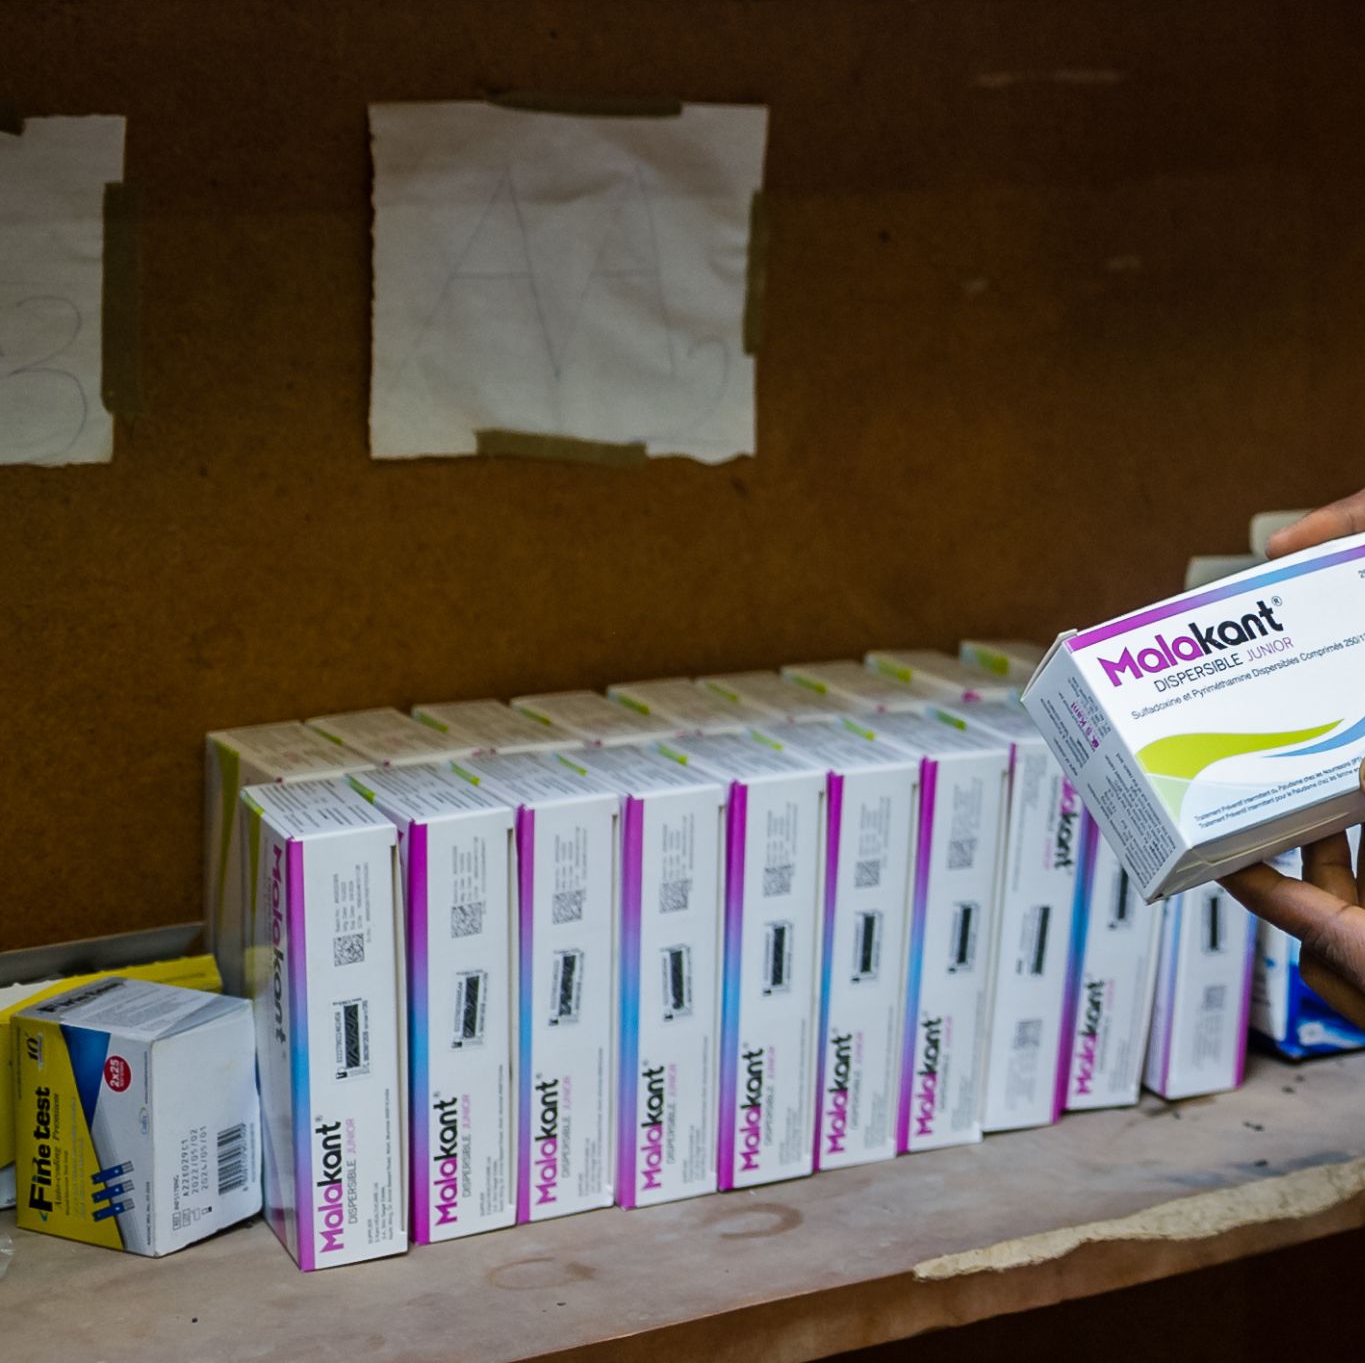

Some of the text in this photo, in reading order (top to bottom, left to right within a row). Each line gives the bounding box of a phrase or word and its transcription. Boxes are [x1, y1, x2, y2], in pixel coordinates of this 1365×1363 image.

[1131, 695, 1182, 720] Sulfadoxine
[1191, 672, 1252, 699] Pyriméthamine
[1252, 656, 1300, 678] Dispersibles
[1300, 640, 1345, 663] Comprimés
[1154, 636, 1295, 693] DISPERSIBLE JUNIOR
[33, 1085, 51, 1141] test
[346, 1118, 358, 1225] DISPERSIBLE JUNIOR
[460, 1134, 472, 1197] DISPERSIBLE
